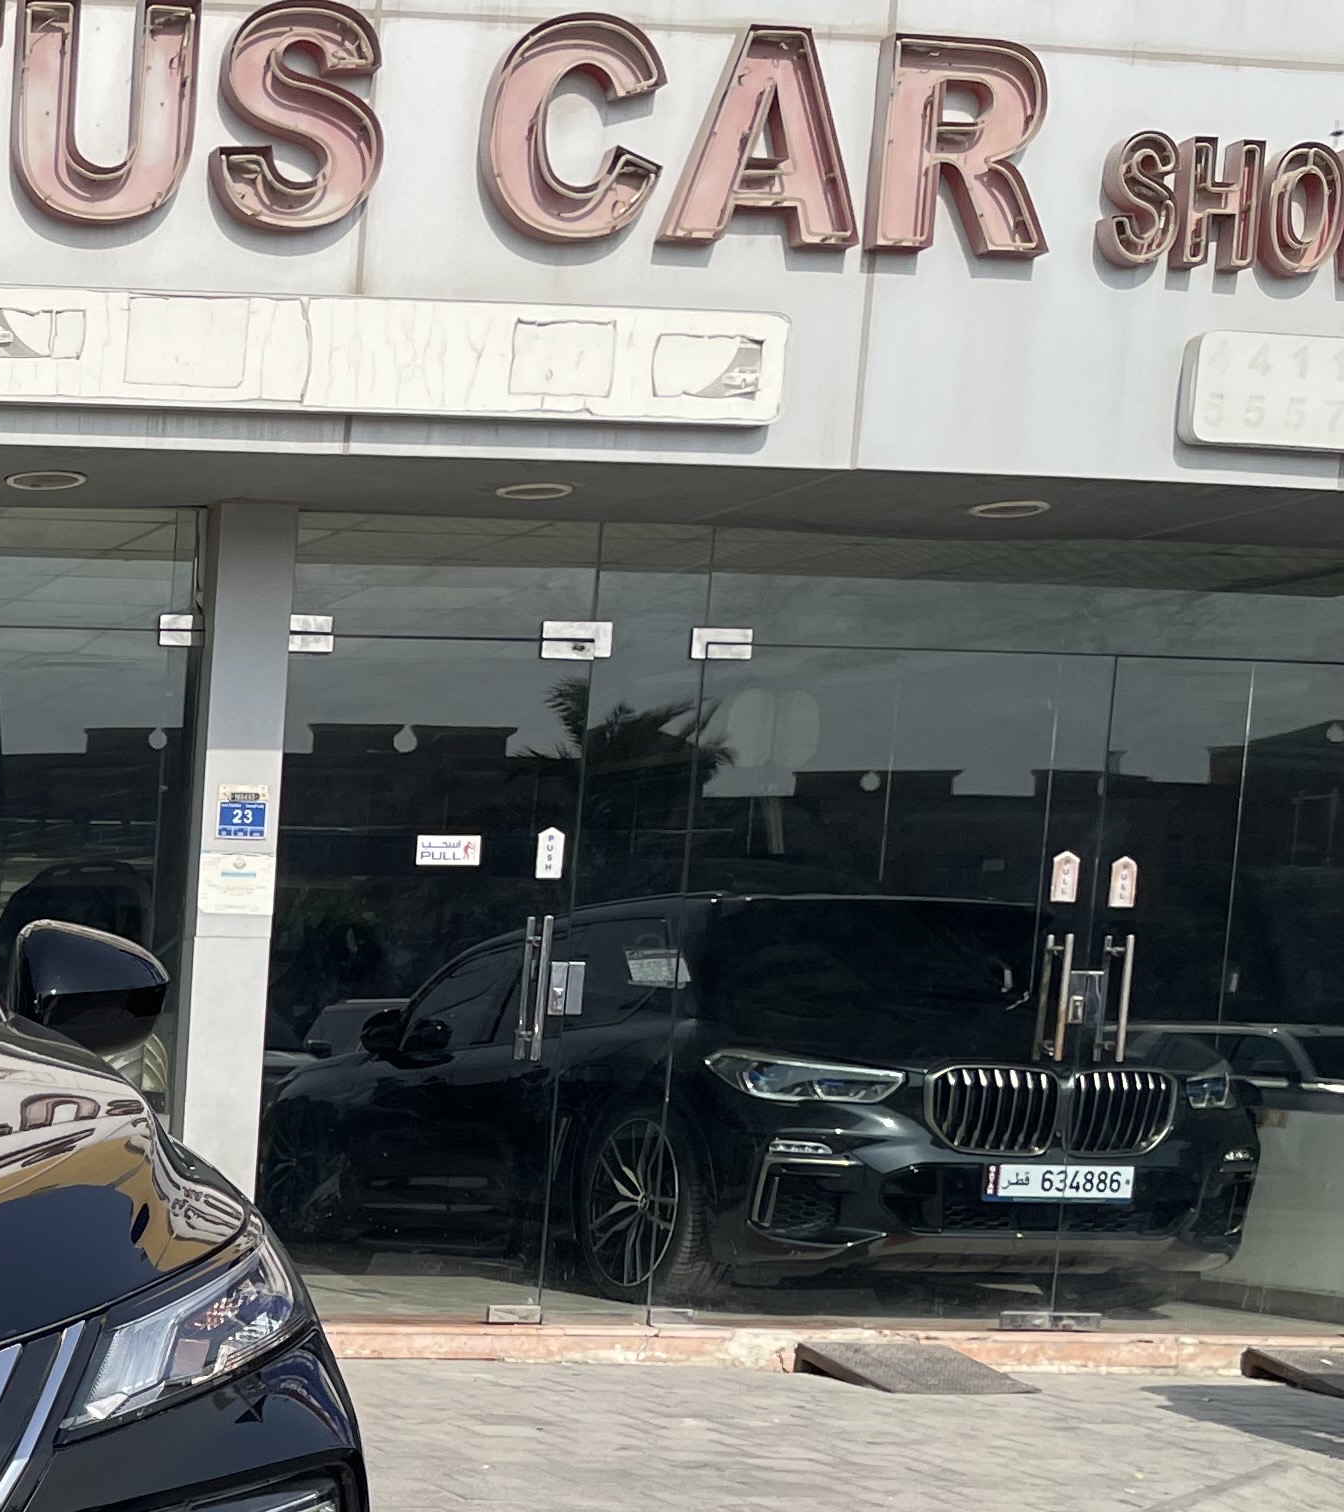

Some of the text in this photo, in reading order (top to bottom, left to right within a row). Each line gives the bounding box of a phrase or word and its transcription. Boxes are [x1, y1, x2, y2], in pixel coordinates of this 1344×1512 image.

[479, 11, 1048, 260] CAR
[231, 808, 253, 823] 23
[420, 851, 461, 860] PULL
[545, 835, 555, 871] PUSH
[1001, 1171, 1030, 1189] قطر
[1041, 1169, 1122, 1193] 634886
